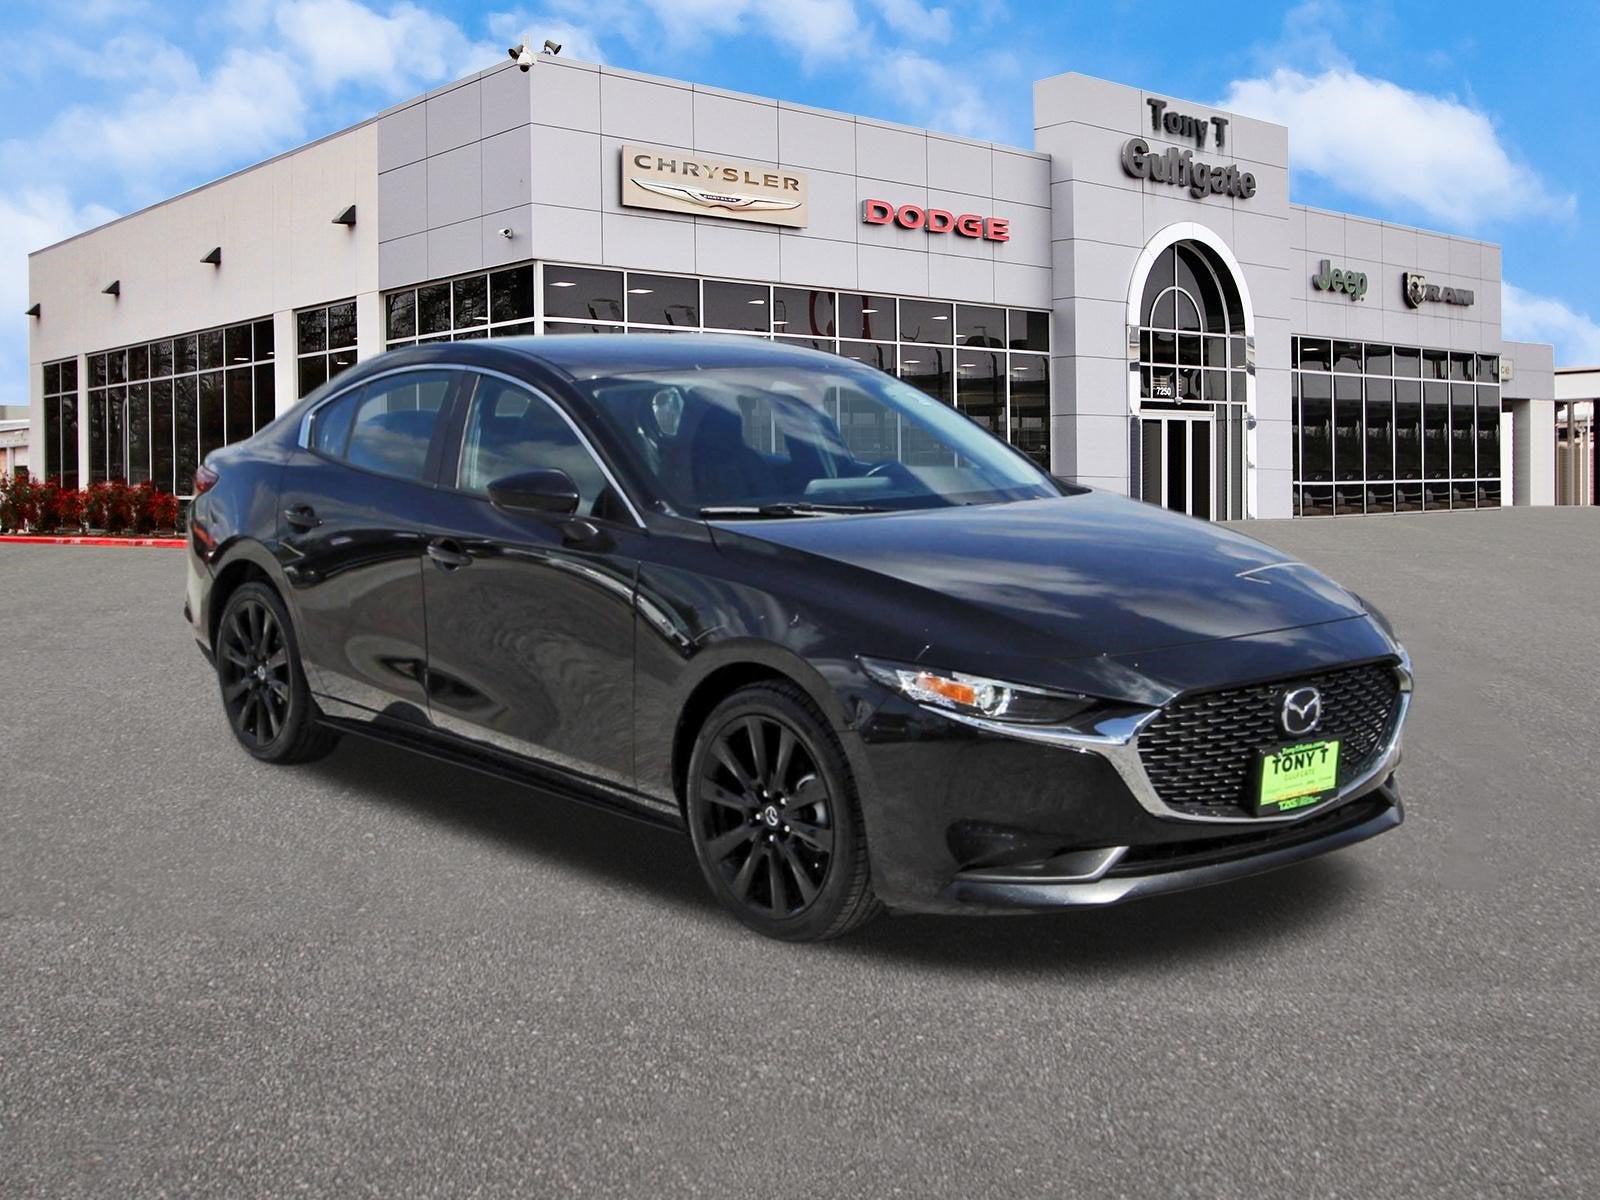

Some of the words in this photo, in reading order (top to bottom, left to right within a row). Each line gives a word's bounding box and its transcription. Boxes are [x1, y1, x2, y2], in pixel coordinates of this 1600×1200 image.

[1146, 98, 1208, 147] Tony
[1211, 116, 1229, 147] T
[633, 154, 800, 192] CHRYSLER
[1121, 137, 1256, 199] Gulfgate
[862, 198, 1010, 242] DODGE
[1312, 259, 1368, 302] Jeep
[1425, 284, 1474, 307] RAM
[1156, 386, 1172, 396] 7250
[1272, 751, 1315, 774] TONY
[1321, 748, 1329, 763] T
